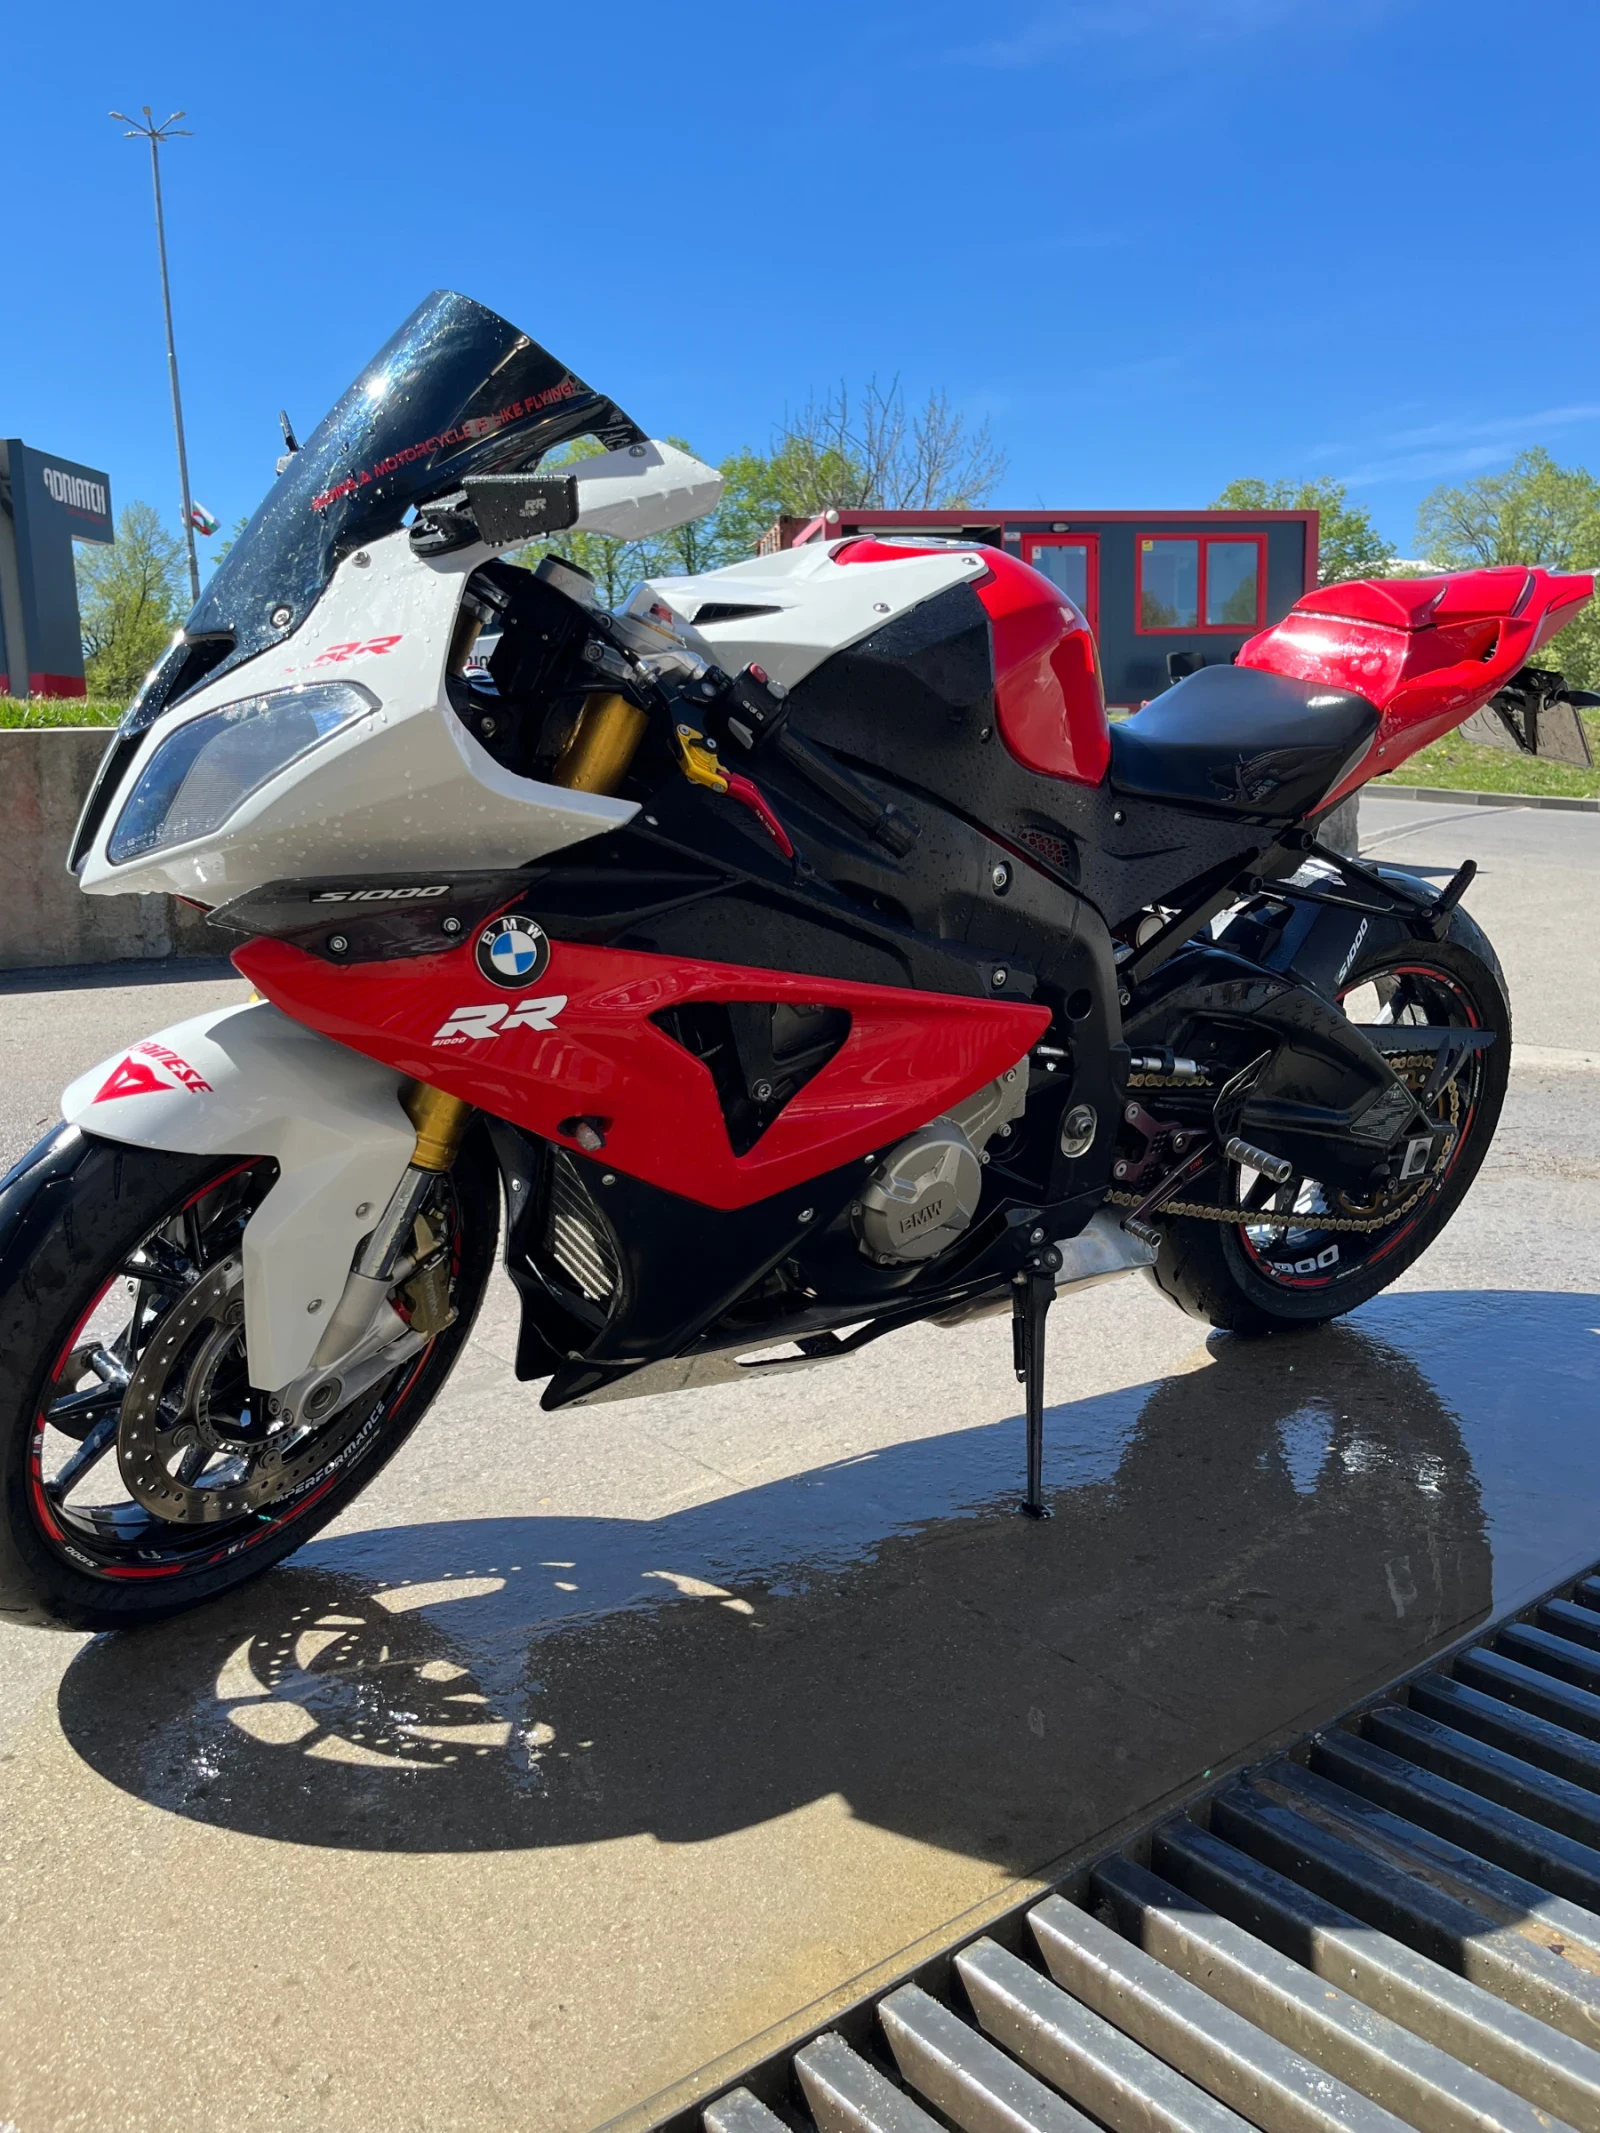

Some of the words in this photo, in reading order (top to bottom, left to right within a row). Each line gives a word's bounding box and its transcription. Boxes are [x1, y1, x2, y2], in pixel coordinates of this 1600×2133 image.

[374, 424, 472, 478] MOTORCYCLE
[475, 416, 489, 433] IS
[491, 402, 523, 427] LIKE
[524, 379, 575, 413] FLYING!
[311, 885, 450, 903] S1000
[481, 918, 542, 946] BMW
[1338, 917, 1369, 985] S1000
[433, 994, 569, 1040] RR
[900, 1200, 944, 1234] BMW
[284, 1400, 386, 1499] PERFORMANCE
